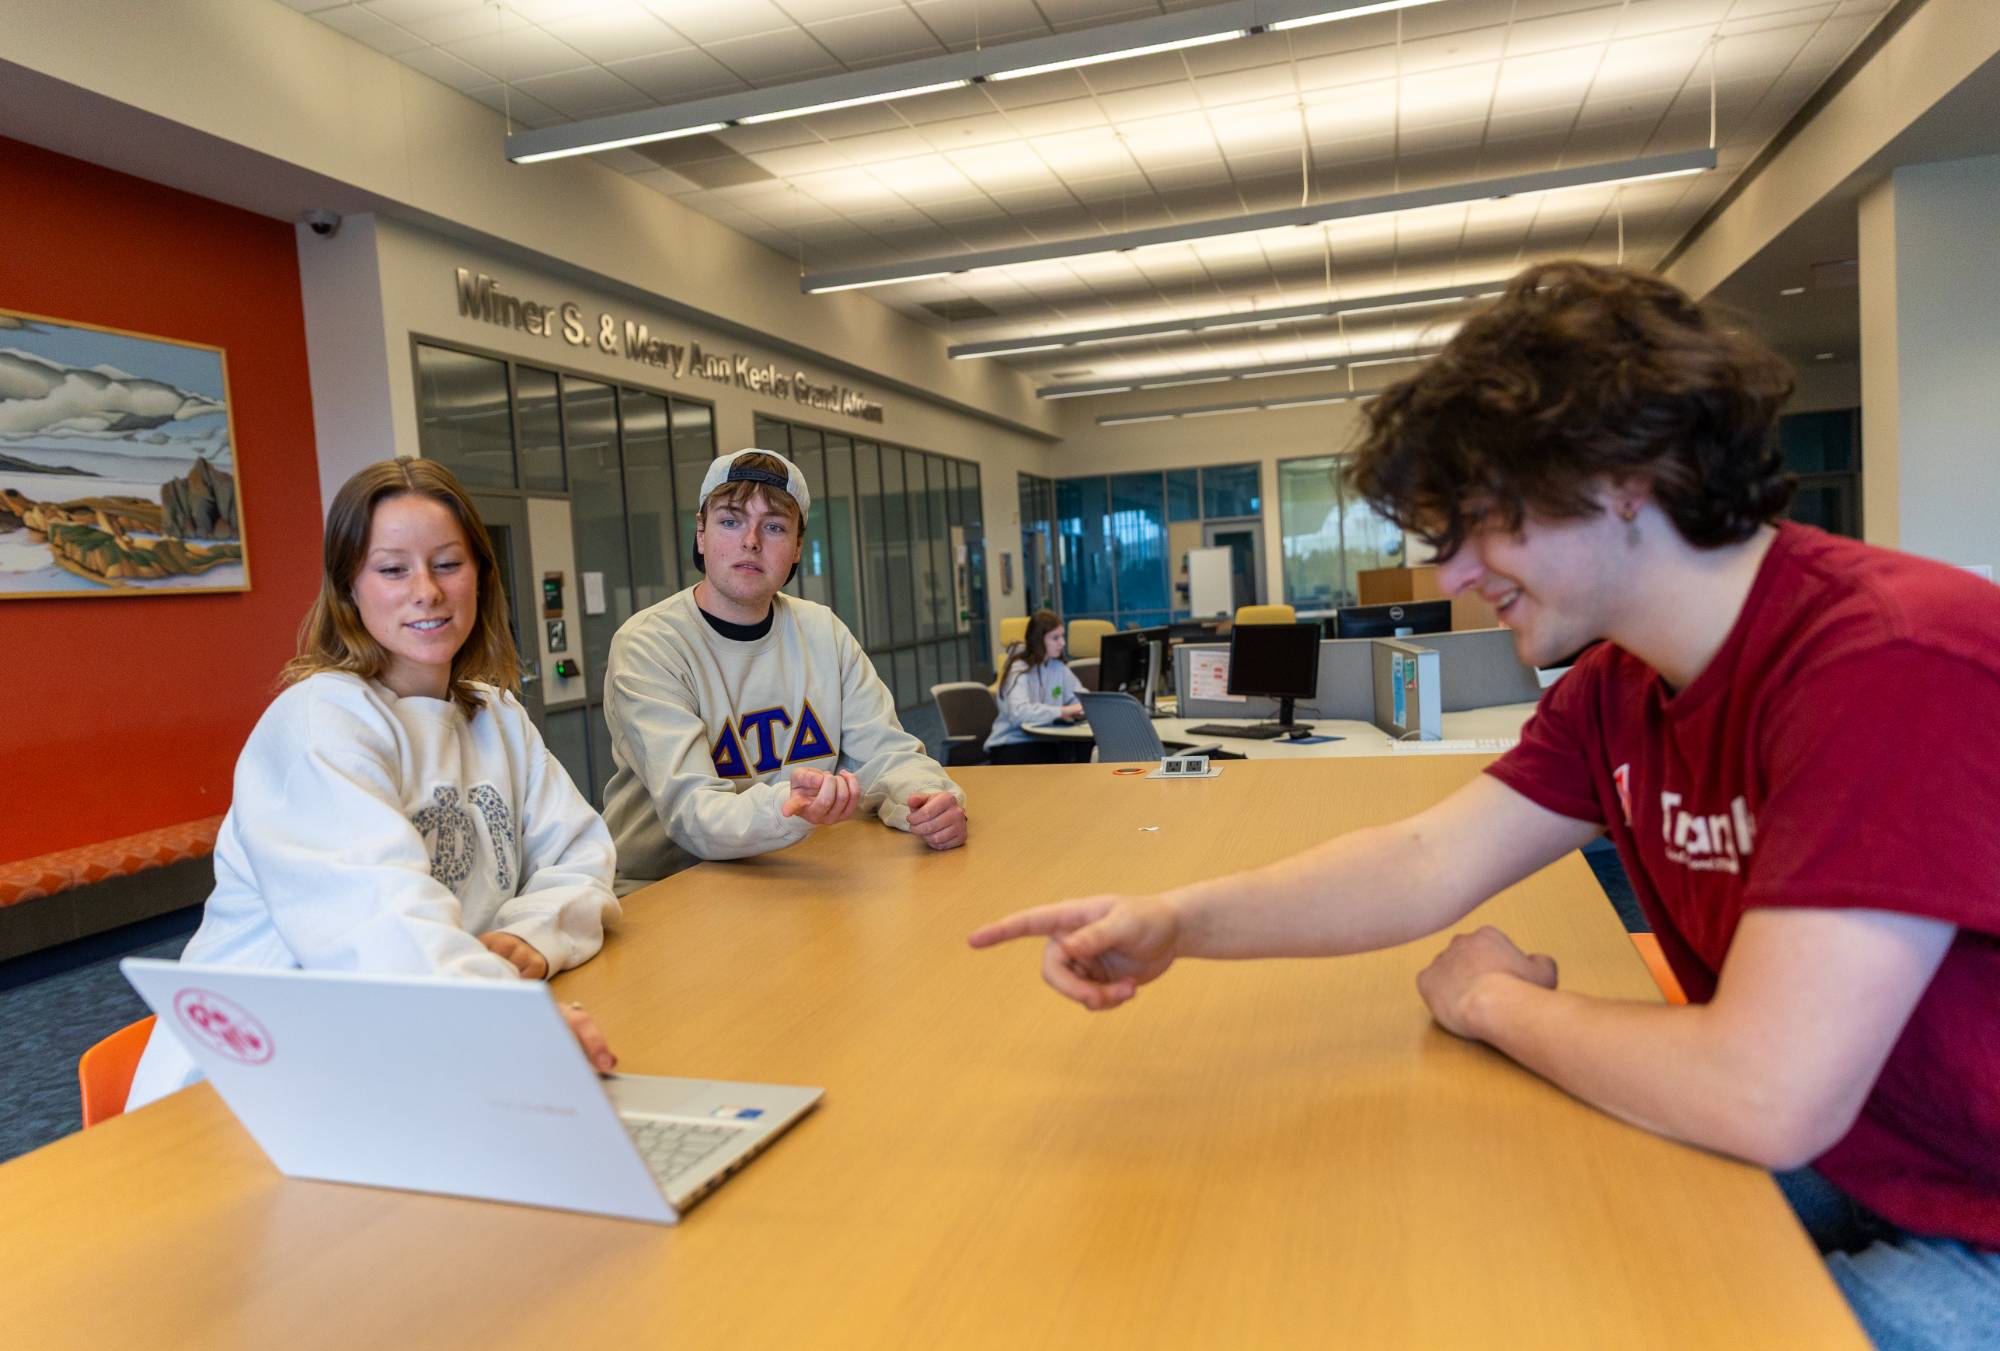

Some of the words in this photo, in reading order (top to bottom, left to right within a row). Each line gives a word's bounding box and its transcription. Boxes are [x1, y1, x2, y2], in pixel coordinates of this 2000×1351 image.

[456, 267, 556, 337] Miner
[561, 302, 592, 348] S.
[599, 312, 619, 355] &
[624, 320, 684, 380] Mary
[690, 340, 731, 384] Ann
[734, 353, 791, 400] Keeler
